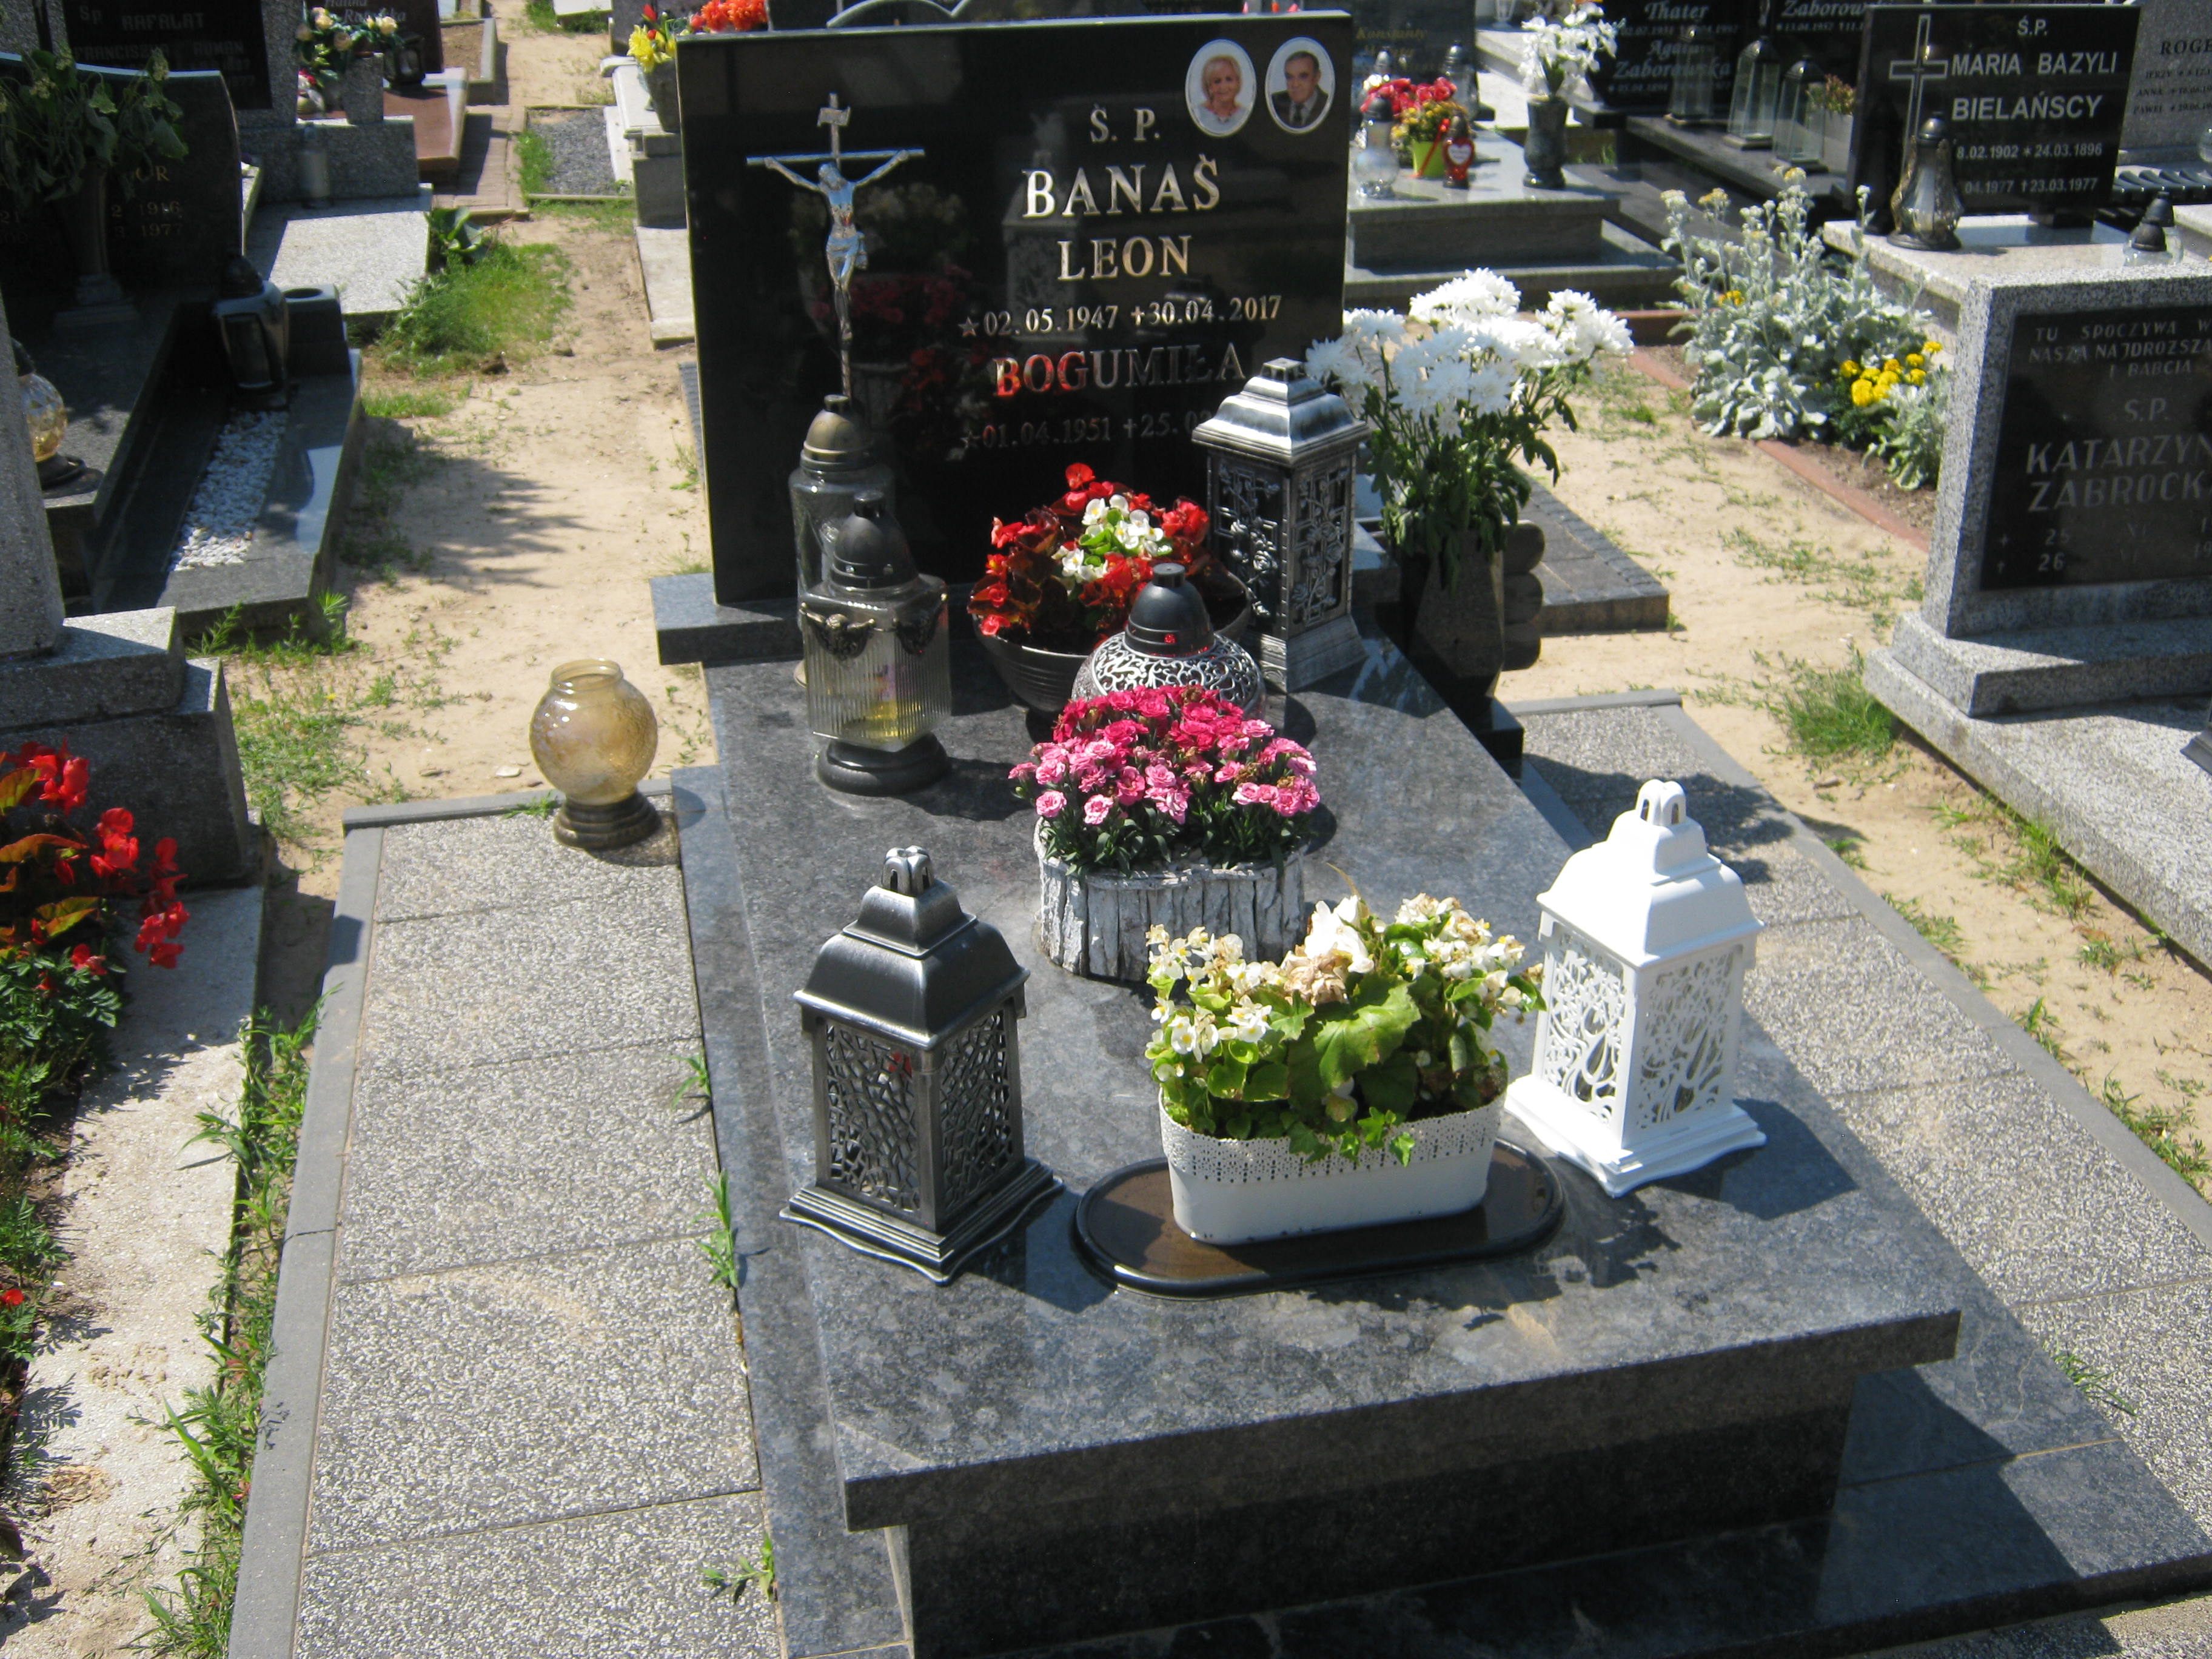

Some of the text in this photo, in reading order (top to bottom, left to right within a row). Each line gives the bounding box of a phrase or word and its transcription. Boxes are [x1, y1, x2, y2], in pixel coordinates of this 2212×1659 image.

[1781, 0, 1865, 18] Zaborow
[1952, 51, 2117, 75] MARIA BAZYLI
[1952, 90, 2103, 121] BIELAŃSCY
[1956, 144, 2019, 159] 8.02.1902
[1965, 179, 2014, 194] 04.1977
[1057, 235, 1193, 281] LEON
[2036, 326, 2059, 342] TU
[2080, 320, 2178, 340] SPOCZYWA
[993, 341, 1246, 398] BOGUMIŁA
[2127, 359, 2193, 378] BABCIA
[2027, 470, 2212, 512] ZABROCK
[2038, 551, 2065, 572] 26
